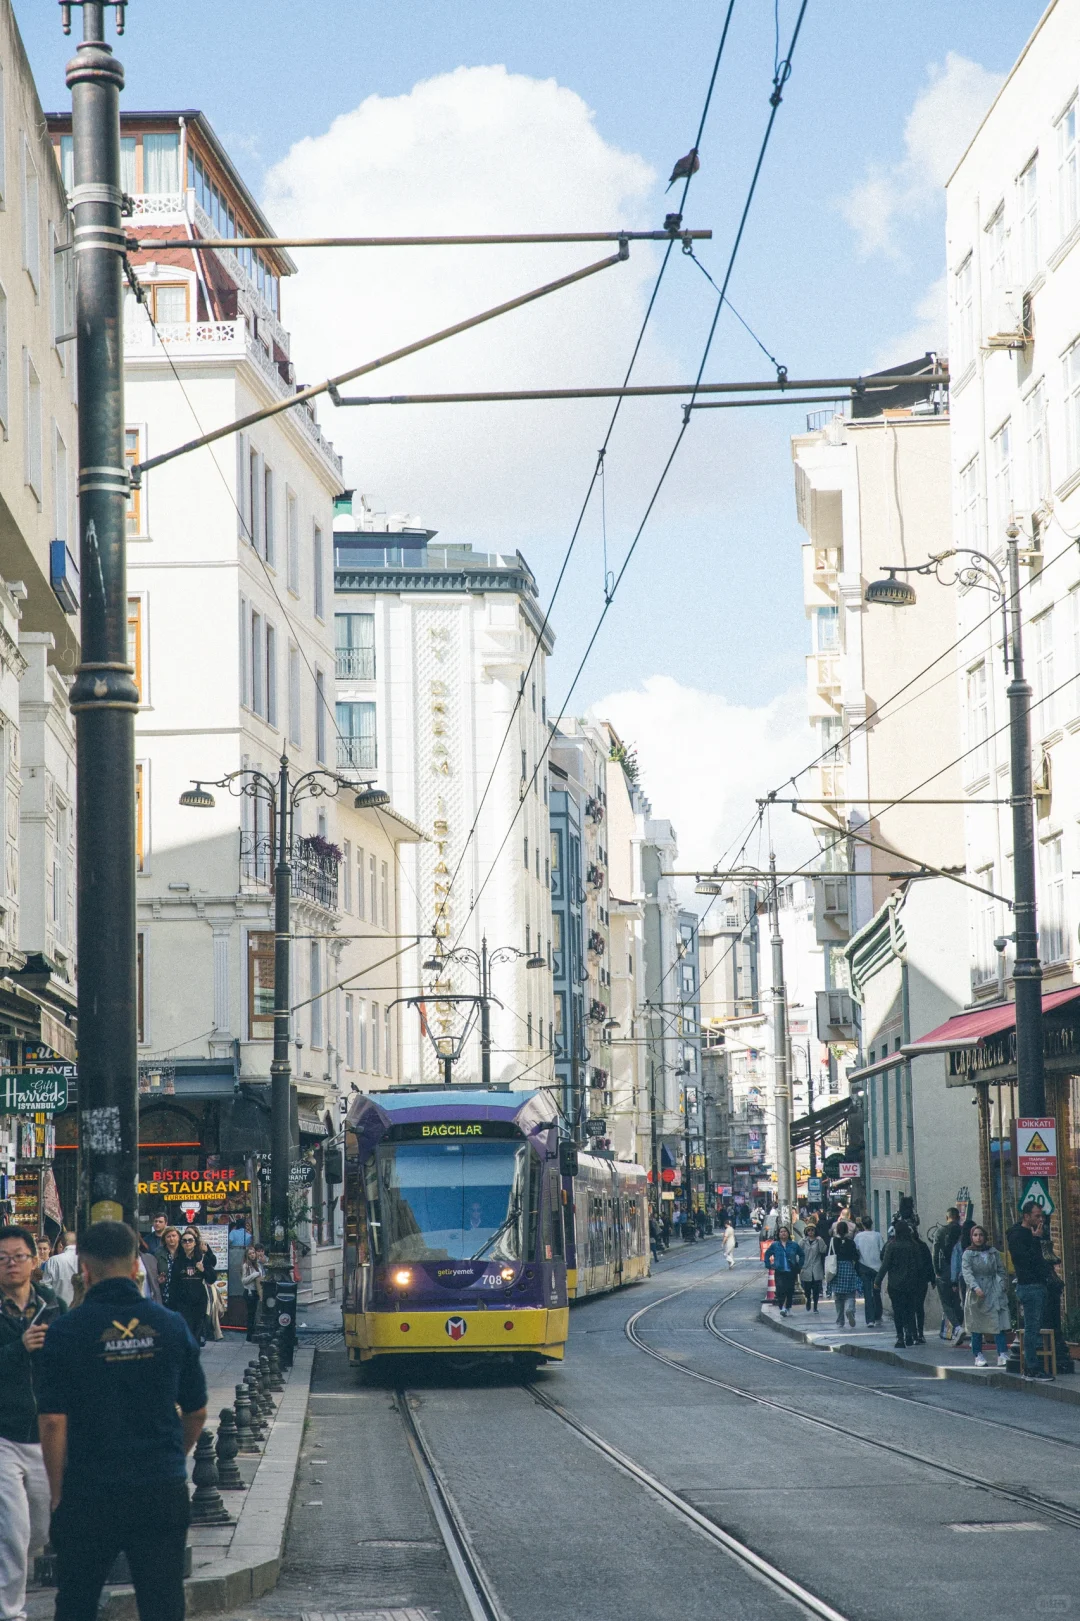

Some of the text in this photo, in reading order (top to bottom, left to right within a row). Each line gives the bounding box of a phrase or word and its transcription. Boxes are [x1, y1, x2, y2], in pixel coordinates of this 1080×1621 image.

[430, 679, 452, 777] DREAM
[0, 1078, 65, 1107] Harrods
[30, 1080, 55, 1093] Gift
[18, 1102, 56, 1110] ISTANBUL
[203, 1169, 235, 1180] CHEF
[137, 1180, 251, 1194] RESTAURANT
[482, 1274, 502, 1285] 708
[105, 1337, 154, 1350] ALEMDAR
